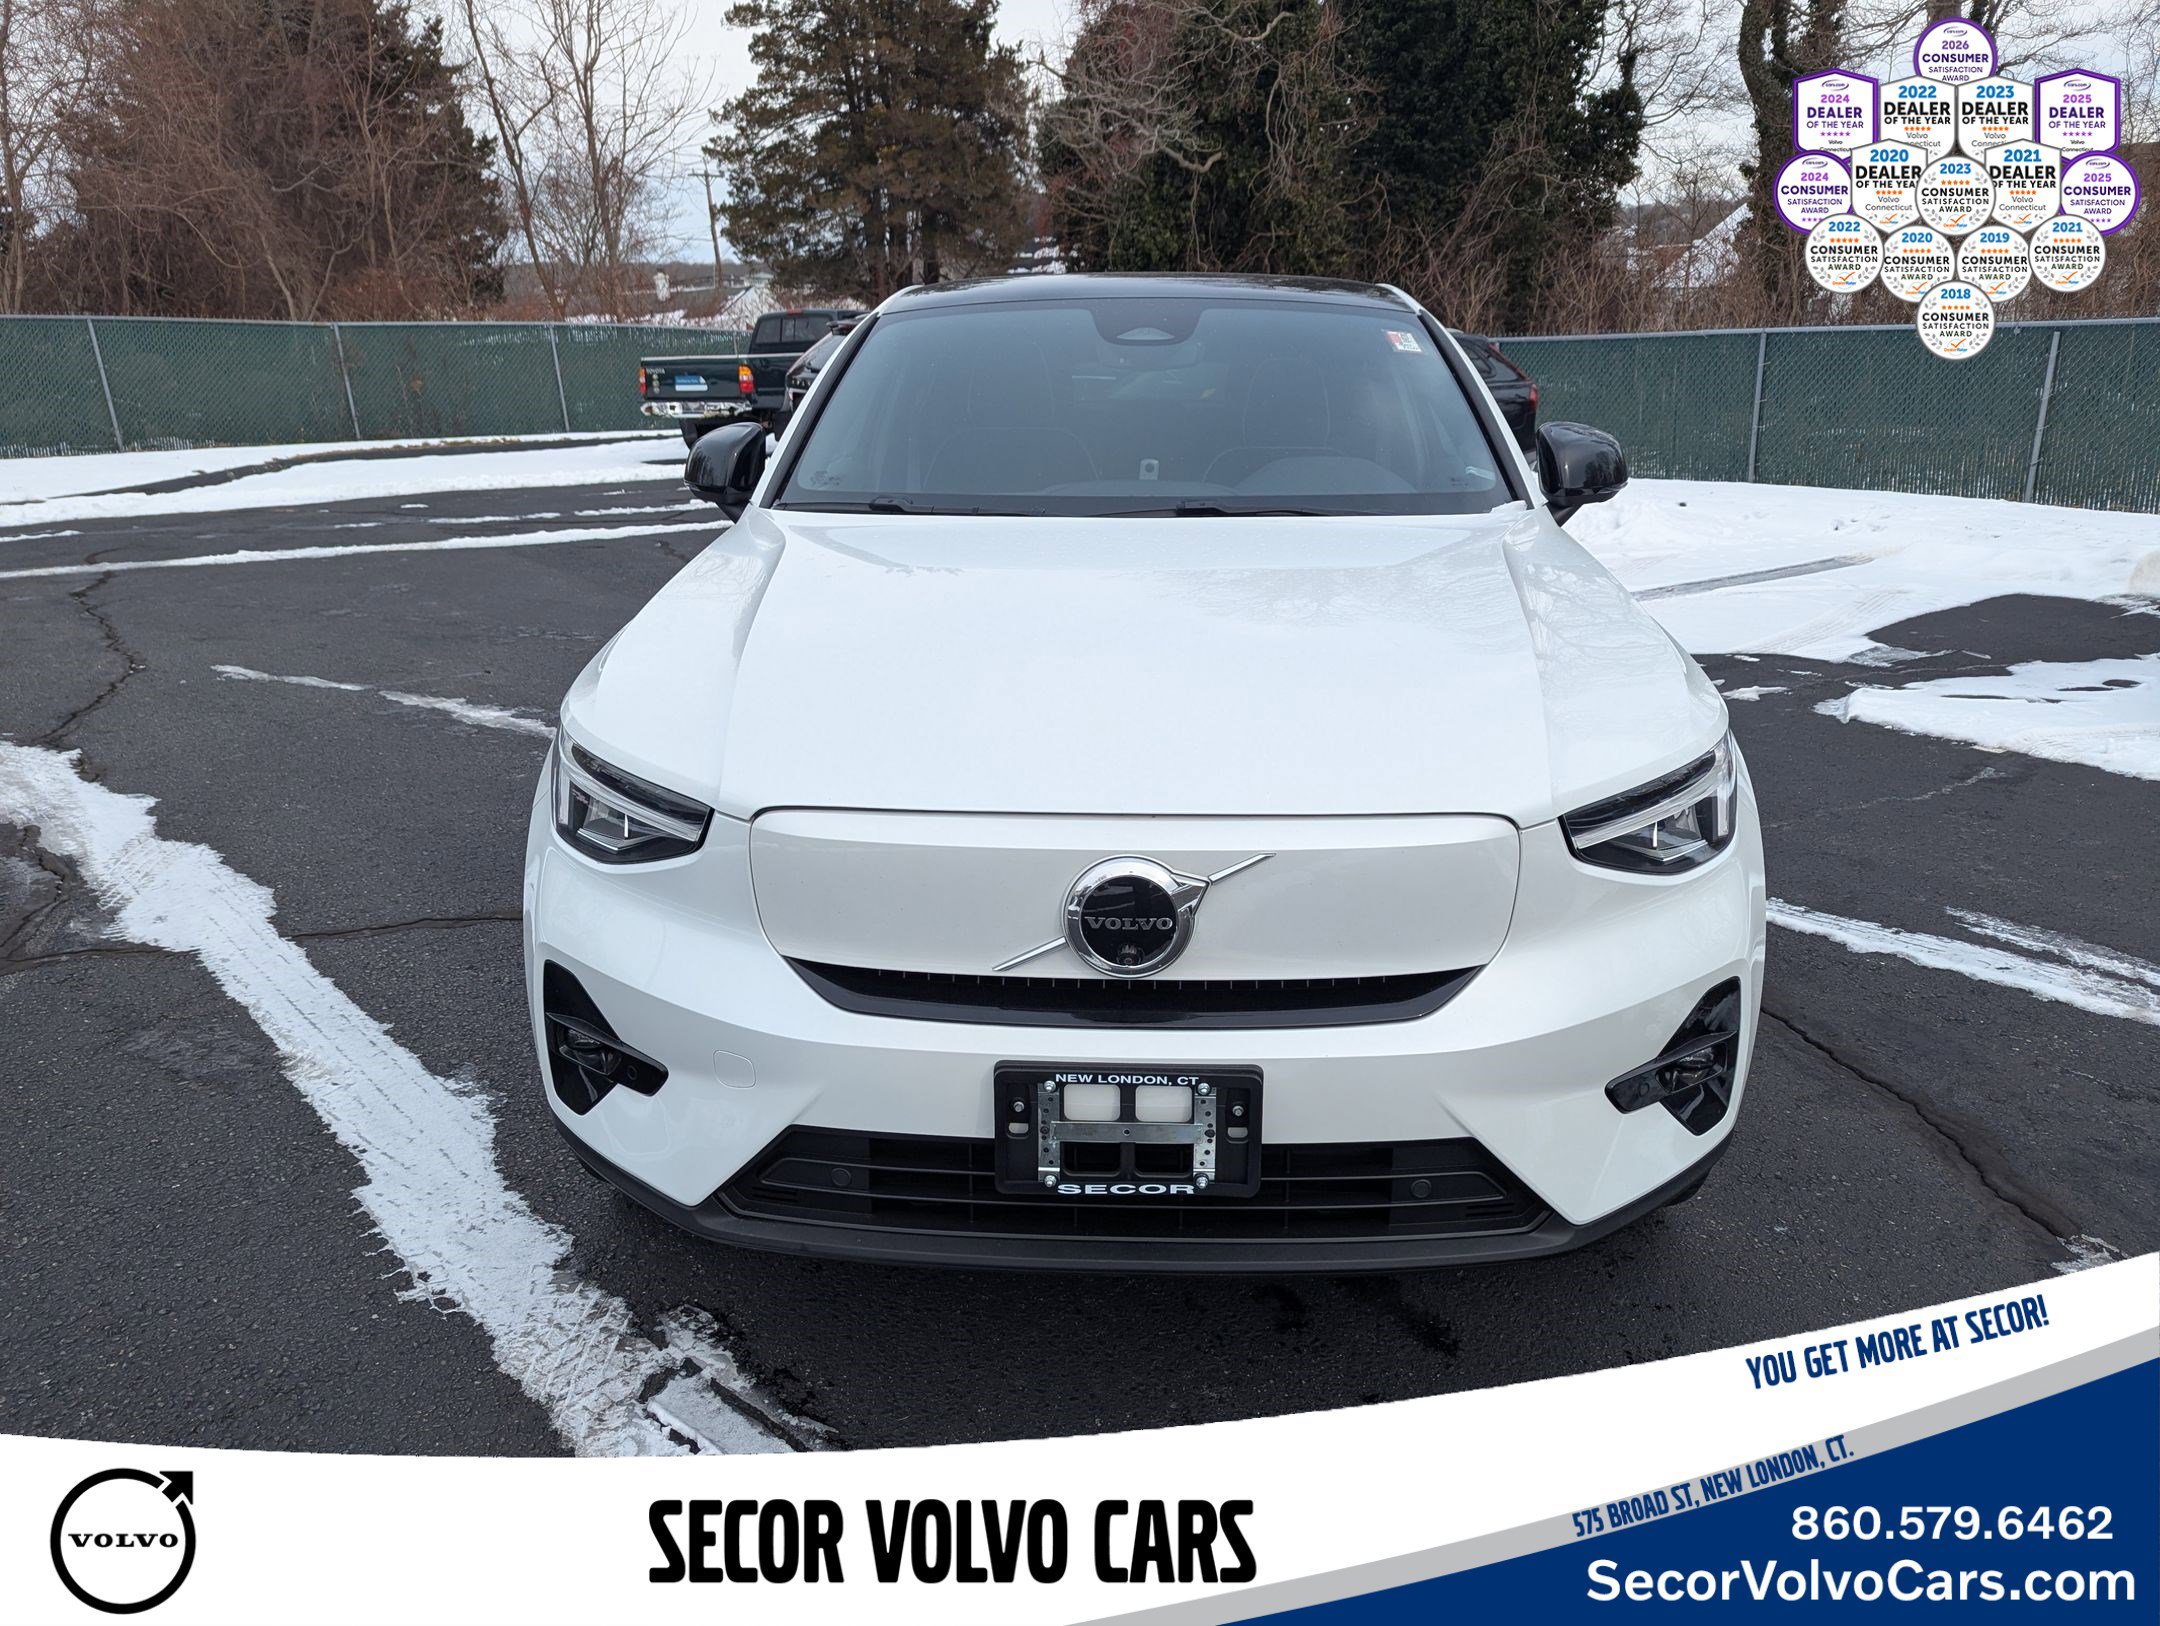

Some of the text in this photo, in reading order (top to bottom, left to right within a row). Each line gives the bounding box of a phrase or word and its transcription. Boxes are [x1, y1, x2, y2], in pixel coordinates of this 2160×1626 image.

[1085, 917, 1173, 930] VOLVO
[1055, 1074, 1199, 1086] NEW LONDON, CT
[1058, 1184, 1194, 1195] SECOR
